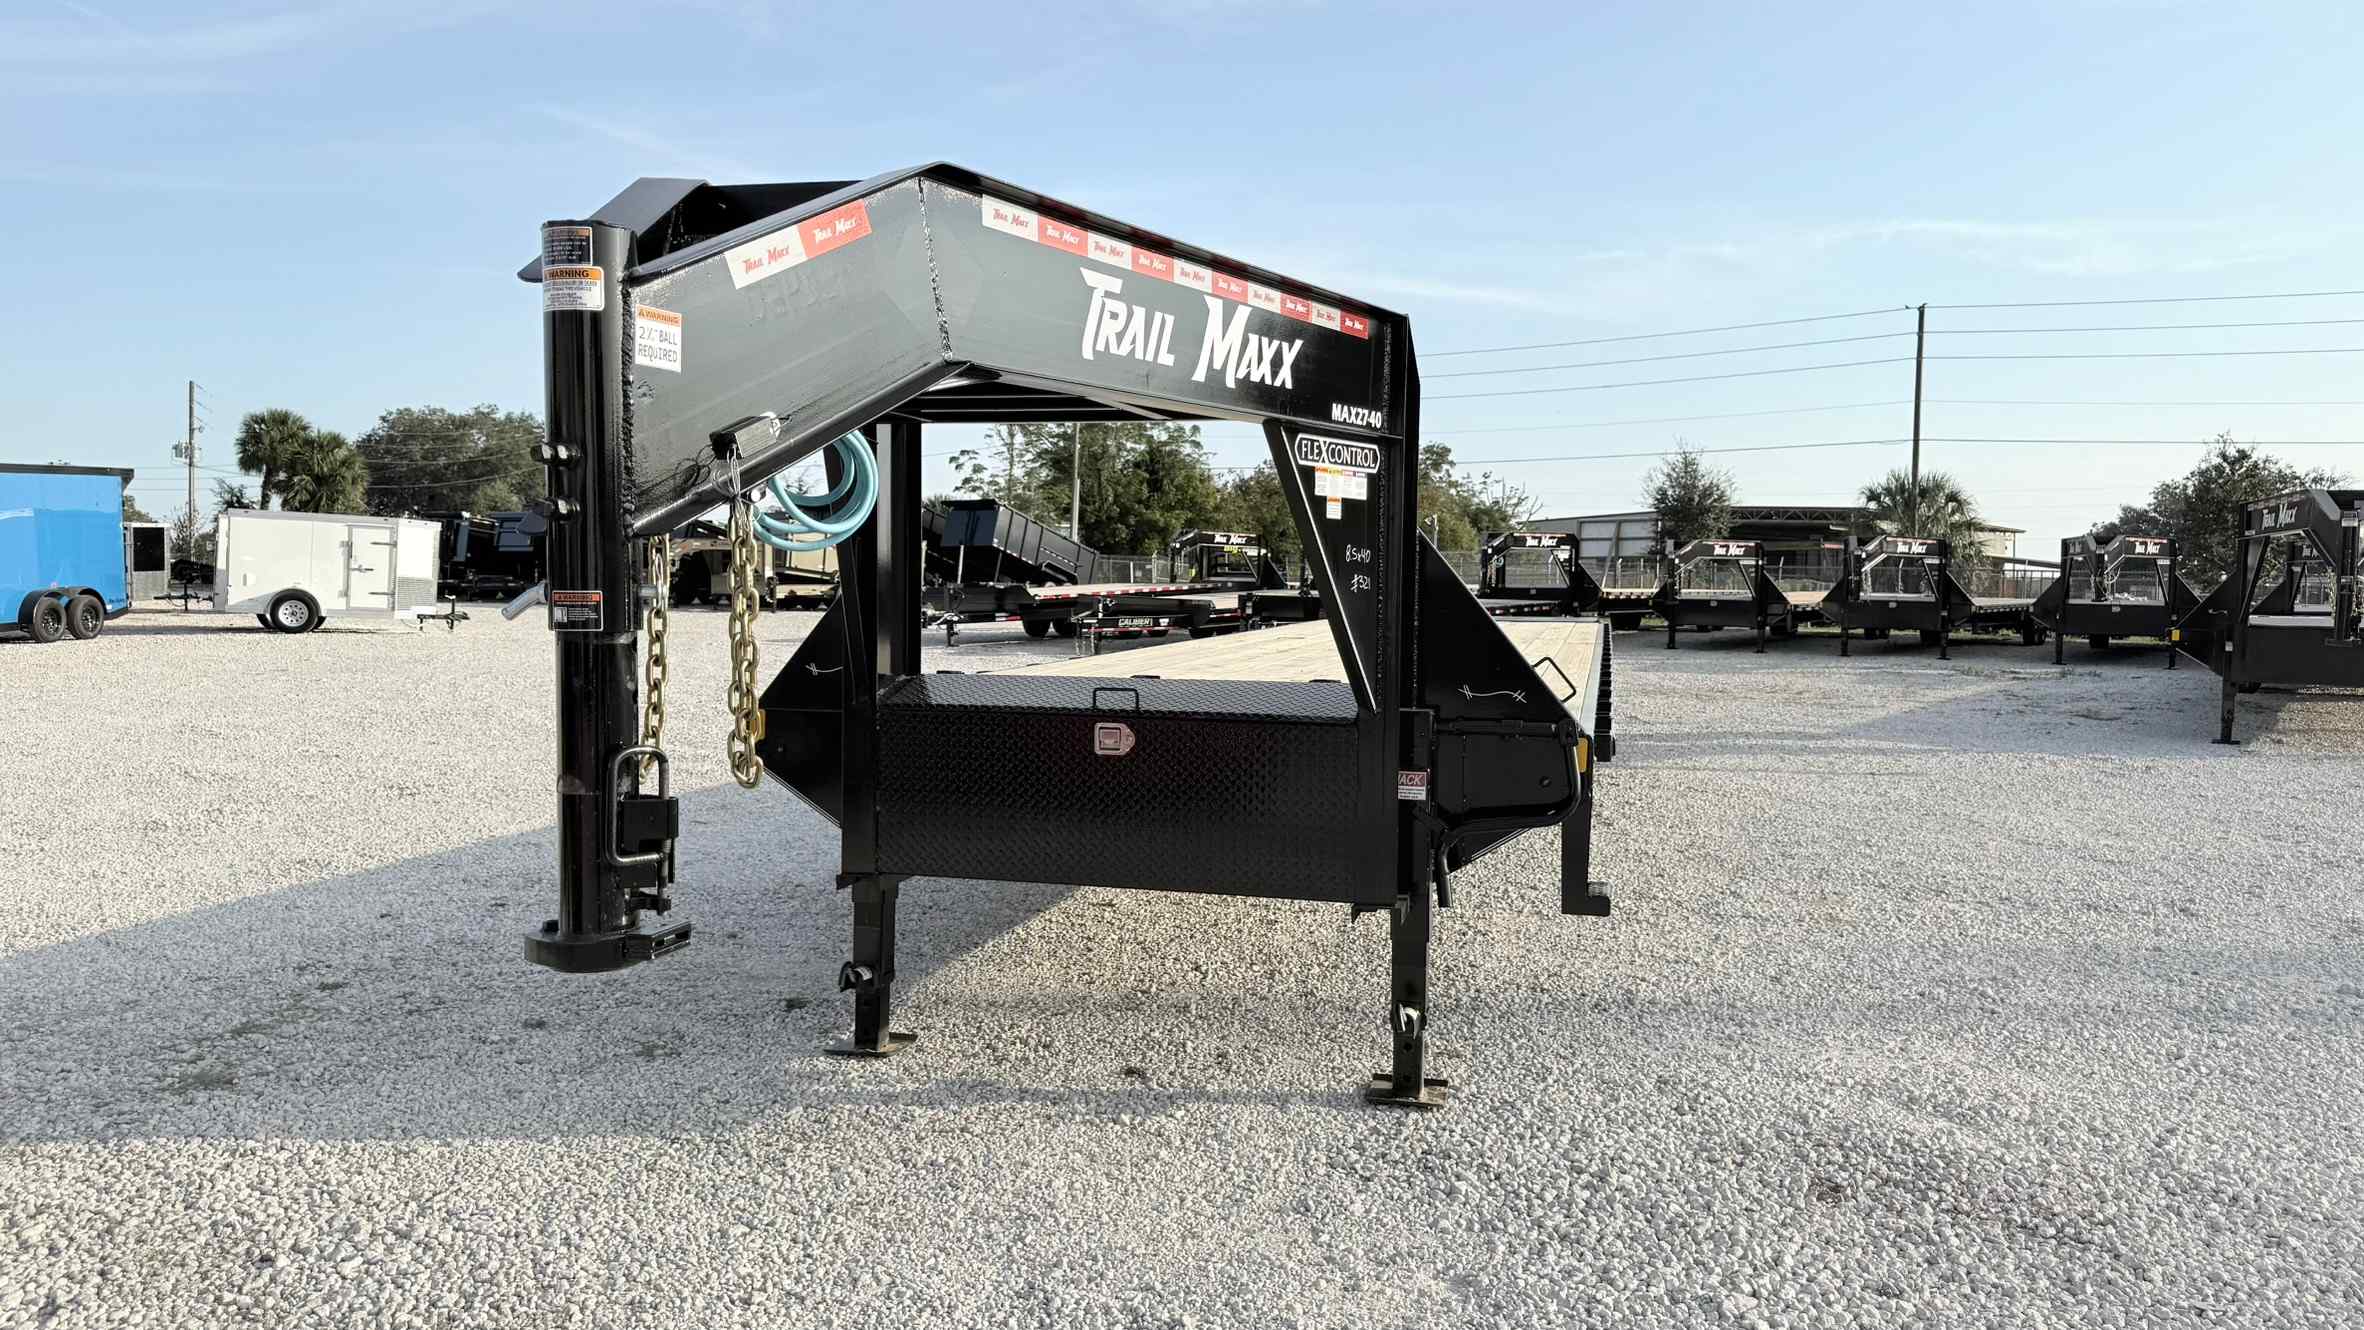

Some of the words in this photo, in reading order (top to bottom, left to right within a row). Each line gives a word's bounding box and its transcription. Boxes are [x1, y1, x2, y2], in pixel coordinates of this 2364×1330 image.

[548, 269, 589, 279] WARNING
[646, 310, 680, 325] WARNING
[1080, 266, 1175, 367] TRAIL
[1191, 294, 1304, 390] MAXX
[659, 329, 678, 346] BALL
[638, 343, 678, 362] REQUIRED
[1301, 438, 1375, 468] FLEXCONTROL
